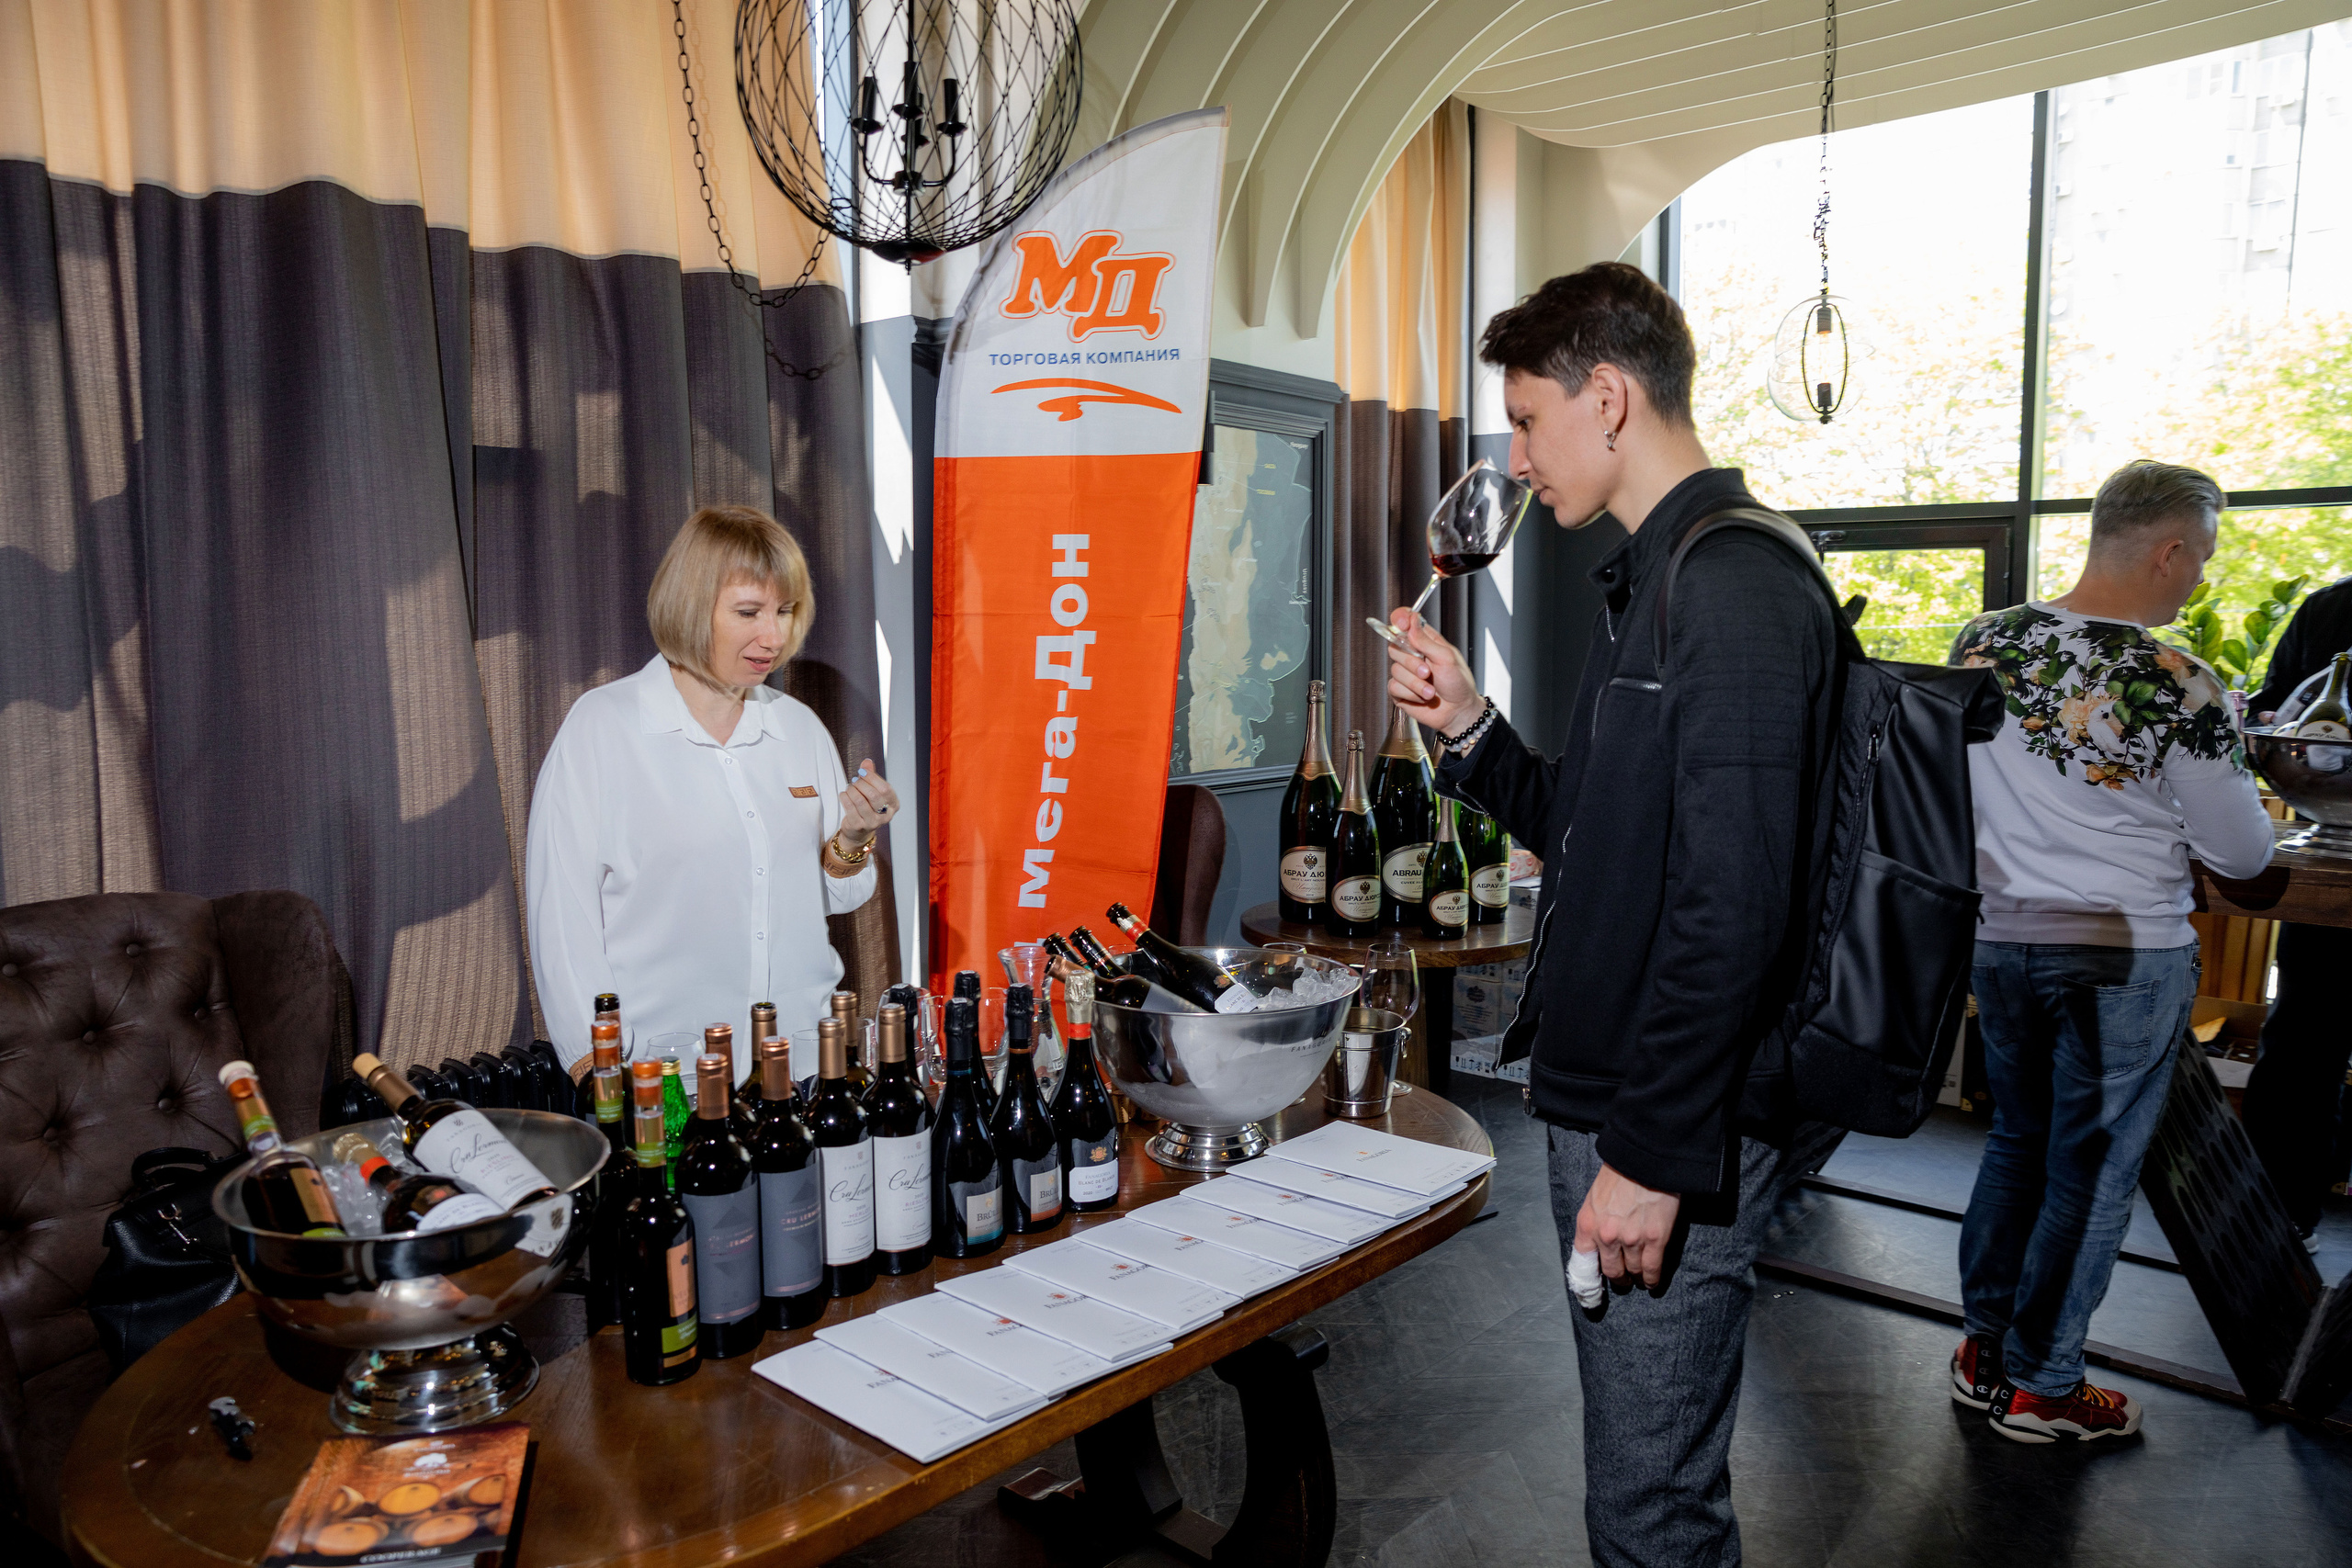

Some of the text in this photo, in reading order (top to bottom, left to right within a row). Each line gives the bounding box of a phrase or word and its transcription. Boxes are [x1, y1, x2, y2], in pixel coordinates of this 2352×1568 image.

[999, 230, 1176, 344] МД
[989, 348, 1181, 367] ТОРГОВАЯ КОМПАНИЯ
[1283, 868, 1308, 878] АБРАУ
[888, 1168, 910, 1190] Cru
[829, 1179, 852, 1202] Cru
